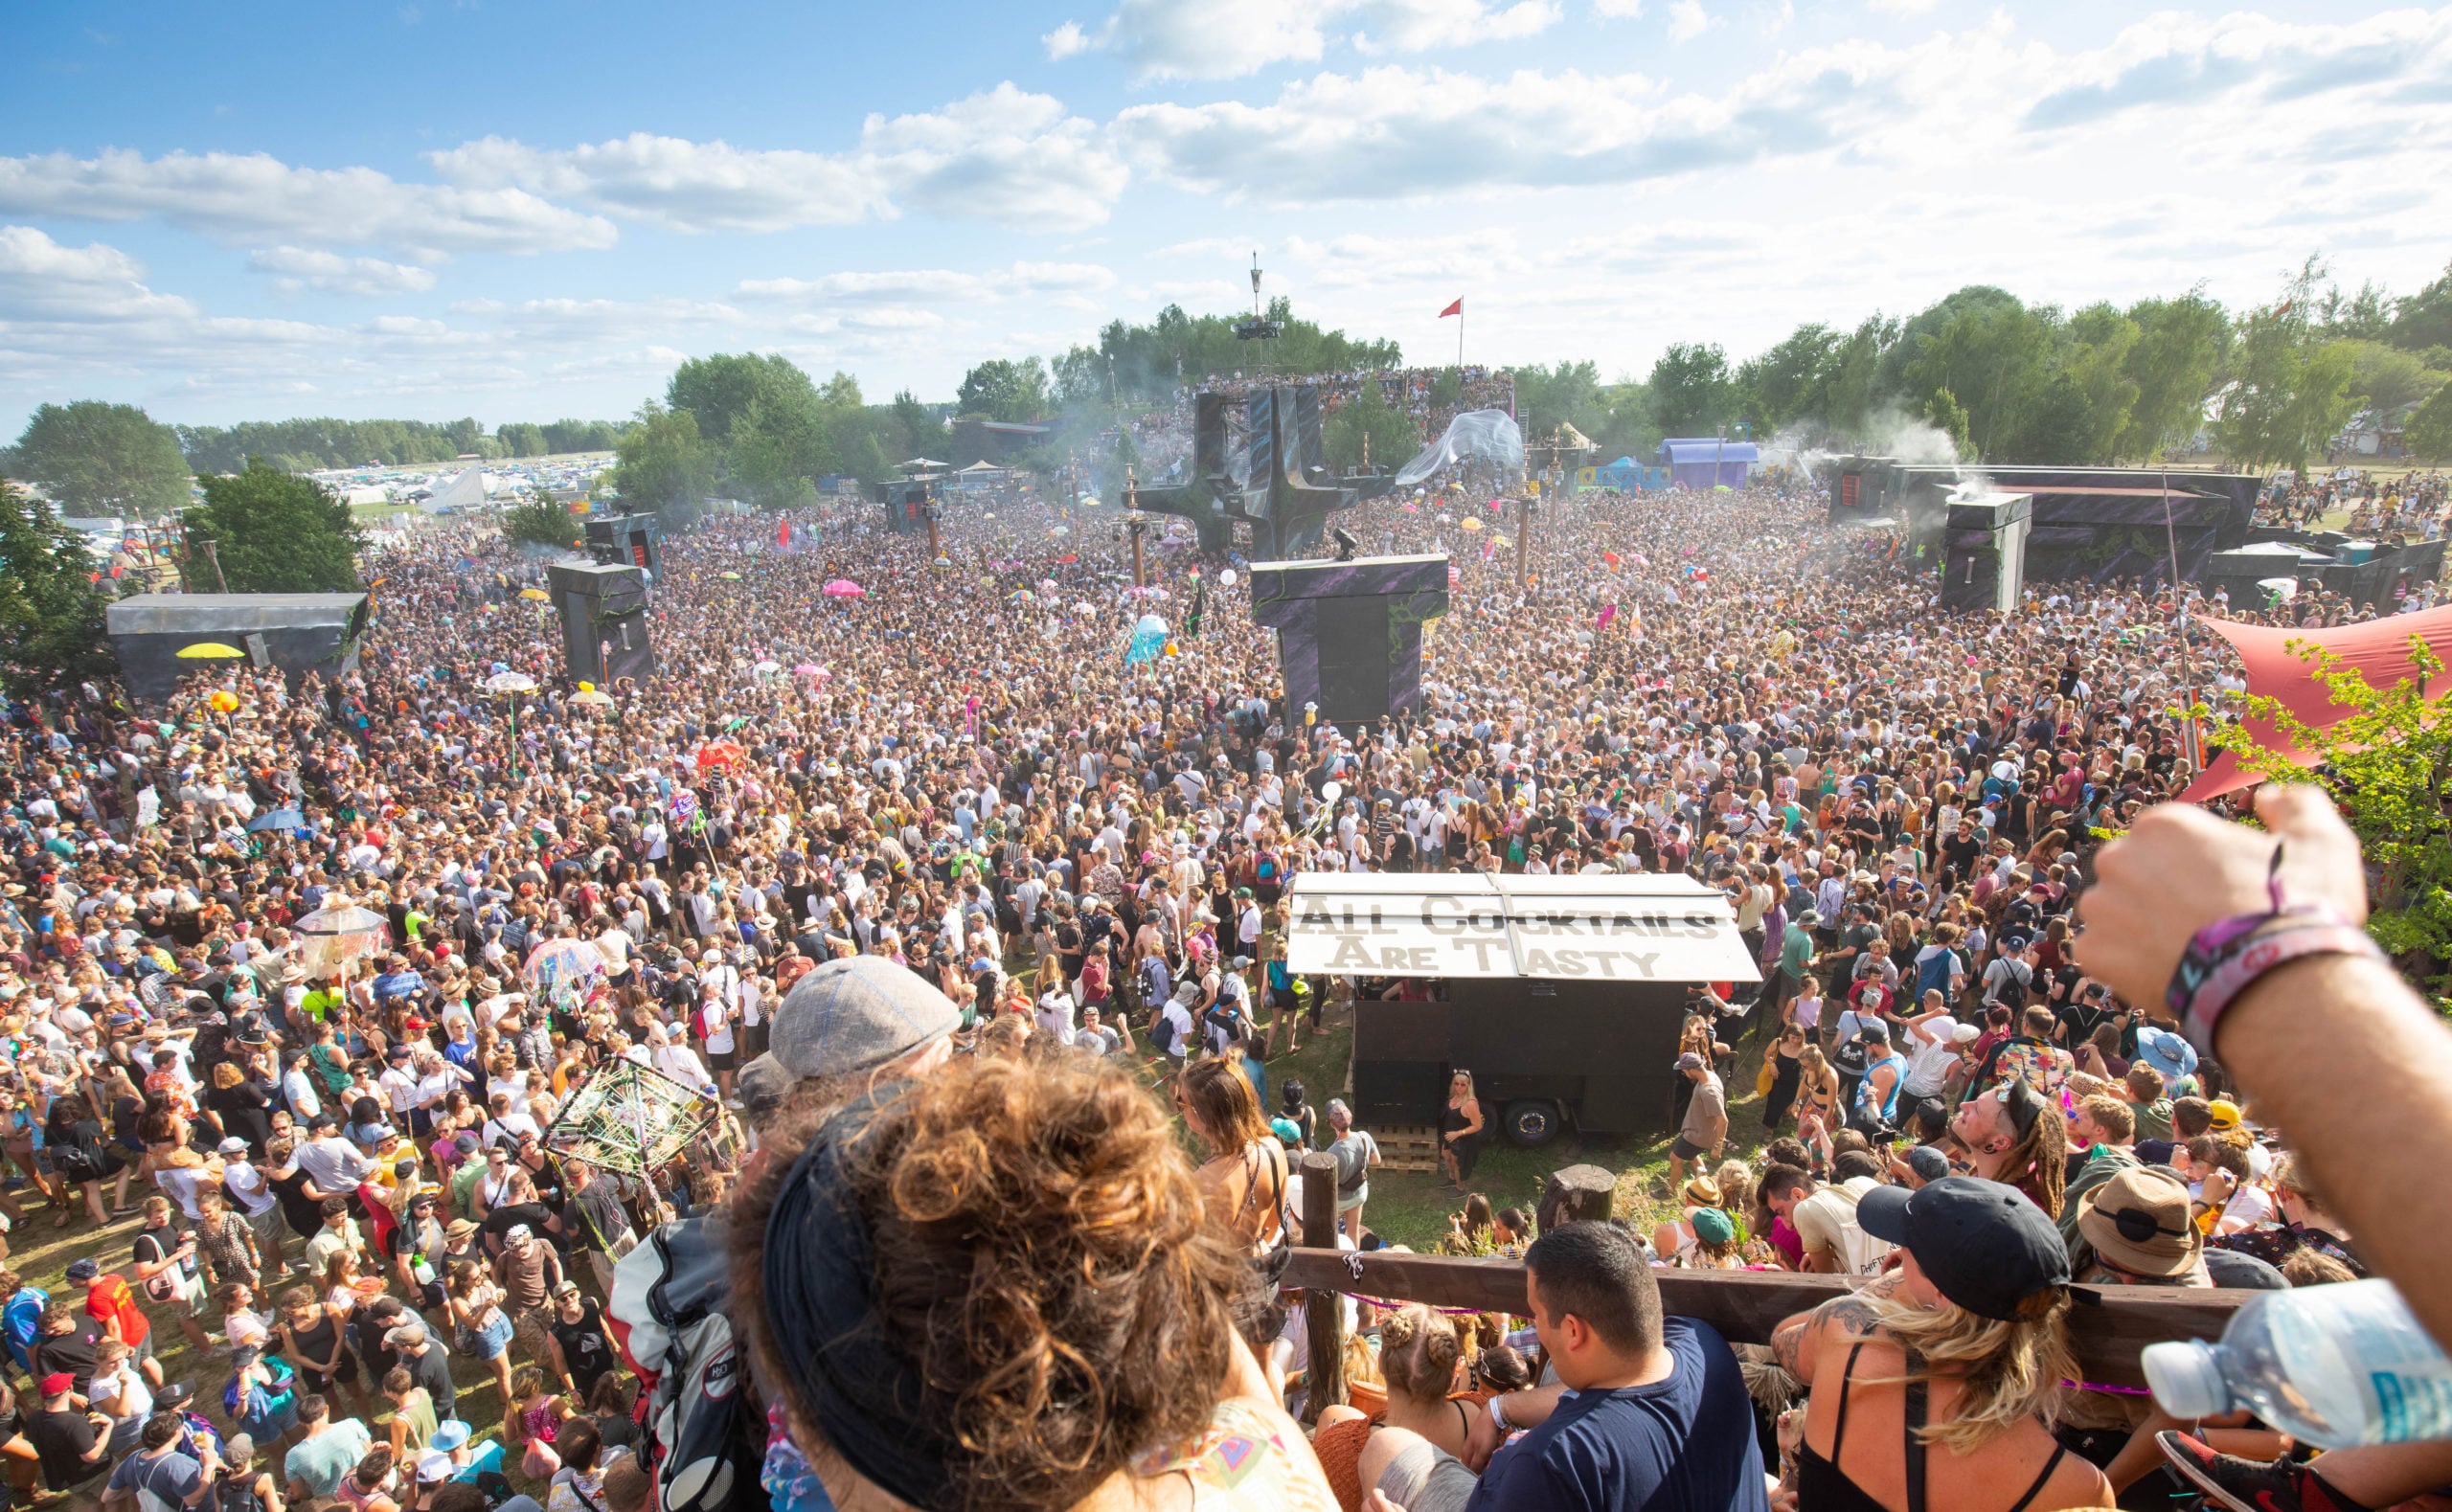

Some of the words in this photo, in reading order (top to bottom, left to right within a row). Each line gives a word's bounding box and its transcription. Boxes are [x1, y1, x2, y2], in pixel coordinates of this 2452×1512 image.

[1291, 895, 1397, 935] ALL
[1420, 895, 1719, 939] COCKTAILS
[1324, 936, 1440, 971] ARE
[1452, 937, 1661, 978] TASTY
